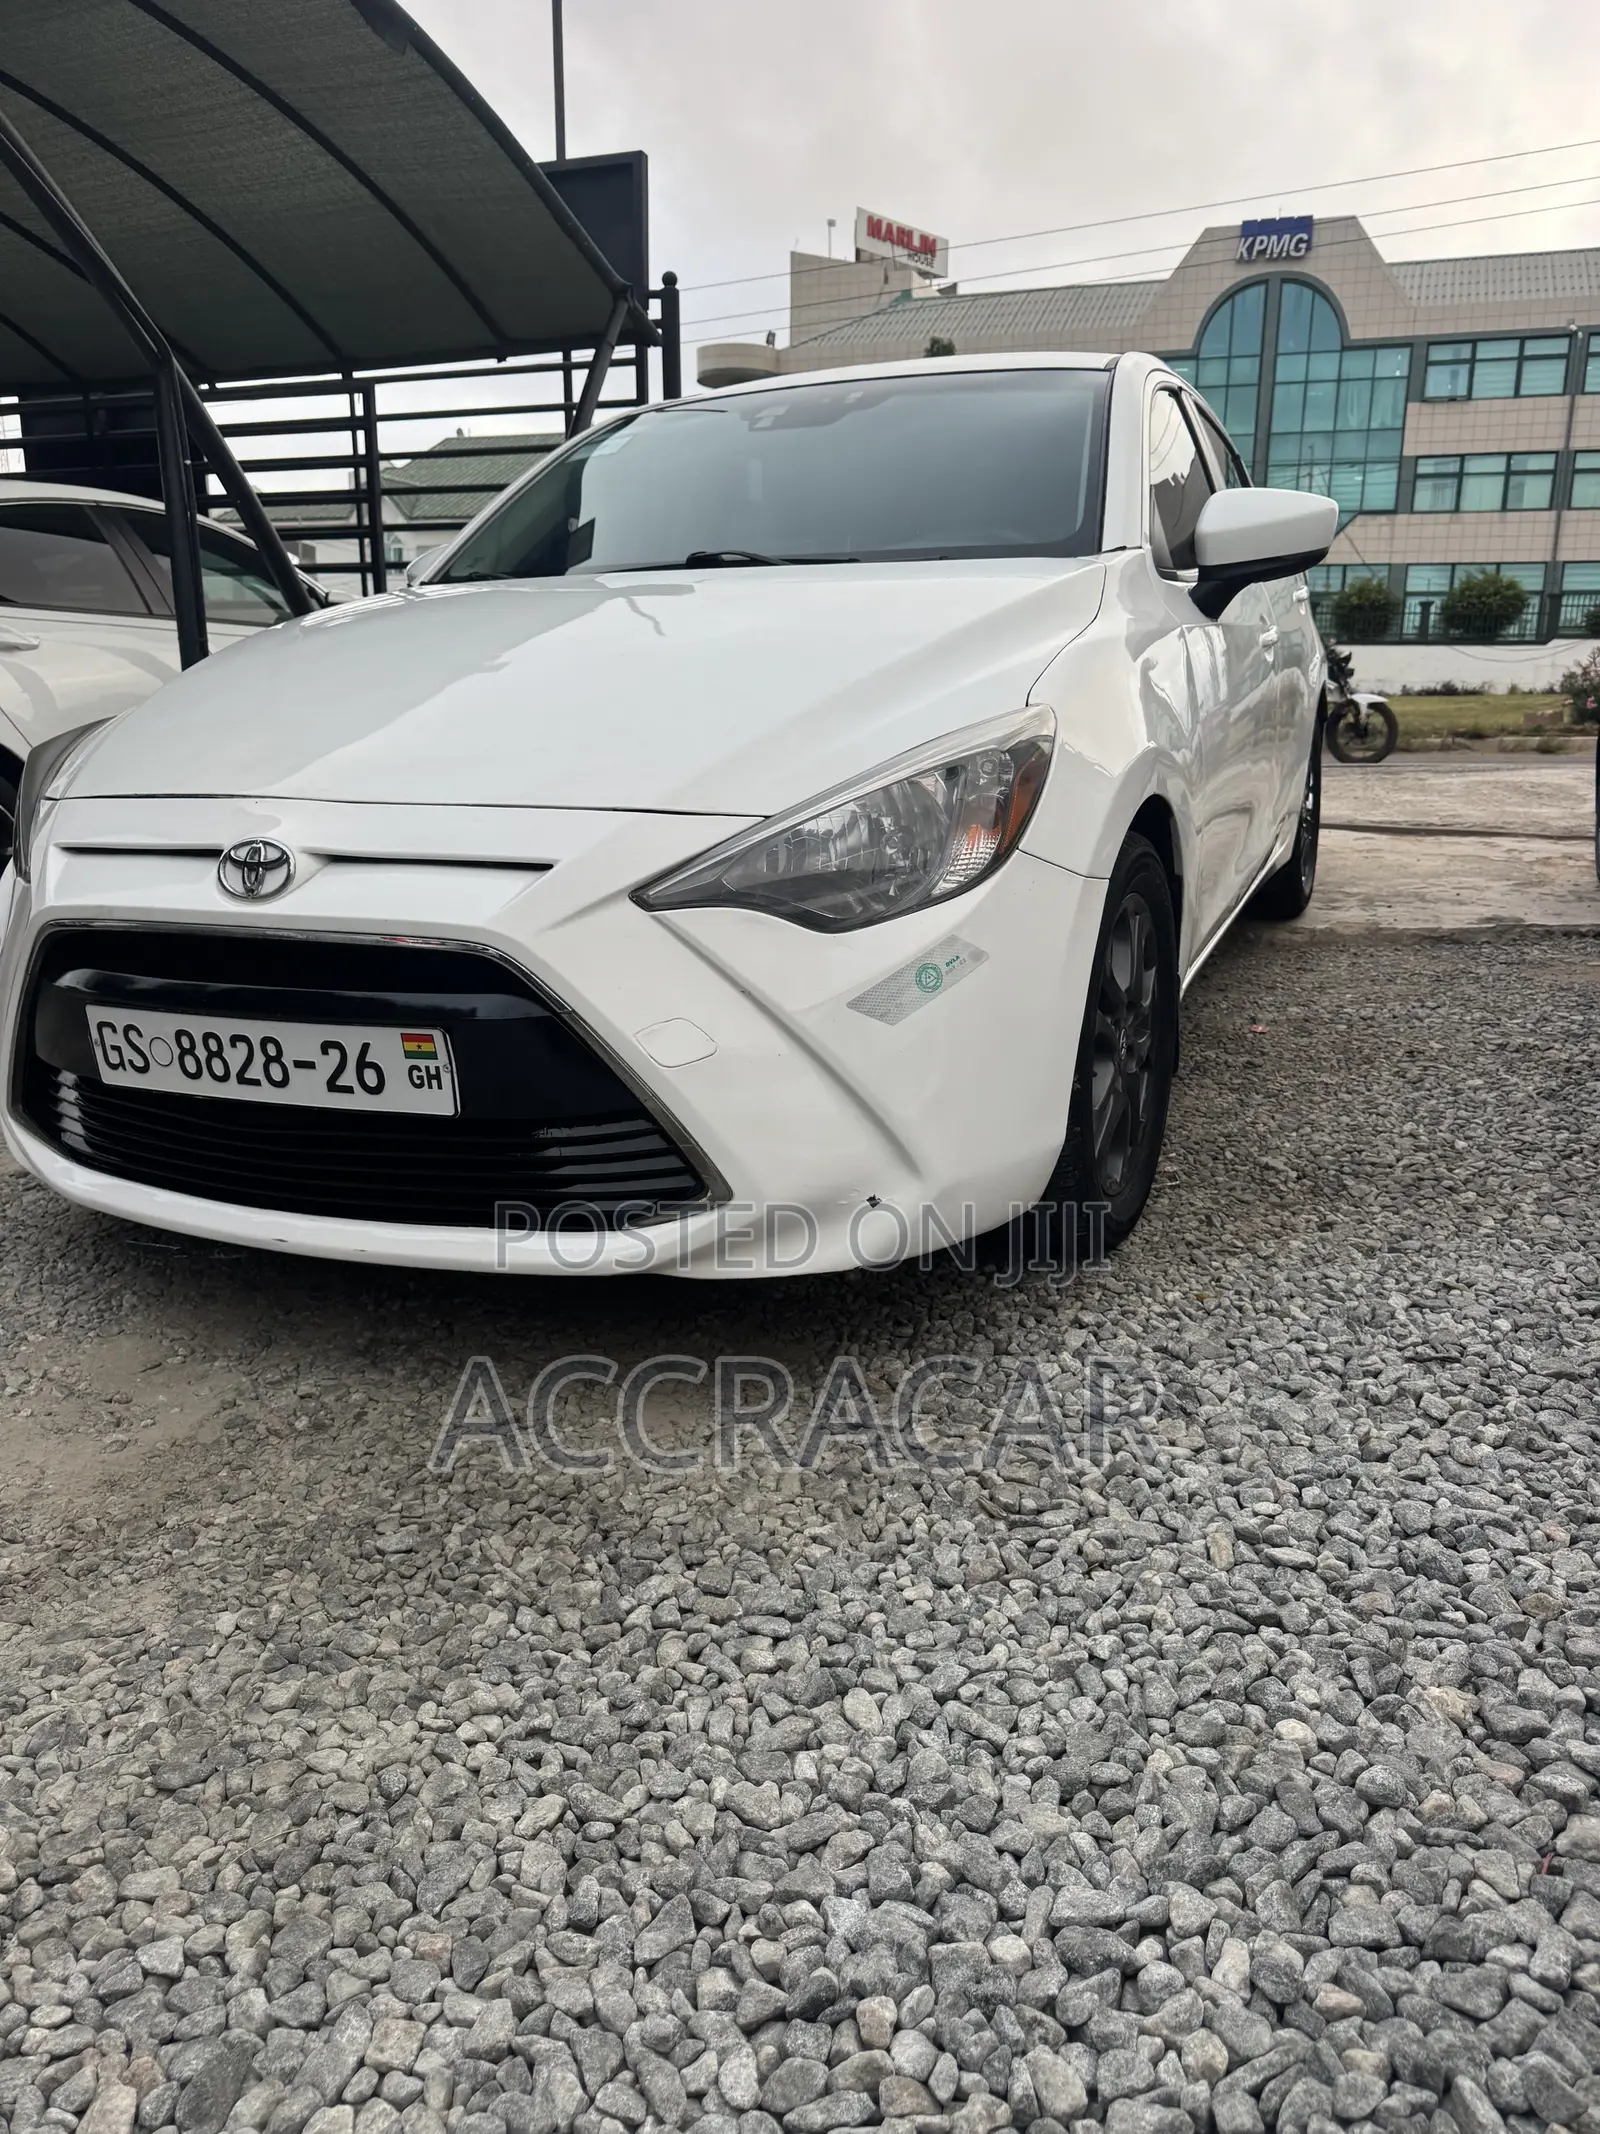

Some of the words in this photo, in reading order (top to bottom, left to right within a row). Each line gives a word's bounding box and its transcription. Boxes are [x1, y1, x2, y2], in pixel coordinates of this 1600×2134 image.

[867, 215, 936, 258] MARLIN
[1236, 233, 1309, 260] KPMG
[174, 1029, 386, 1095] 8828-26
[407, 1064, 443, 1091] GH
